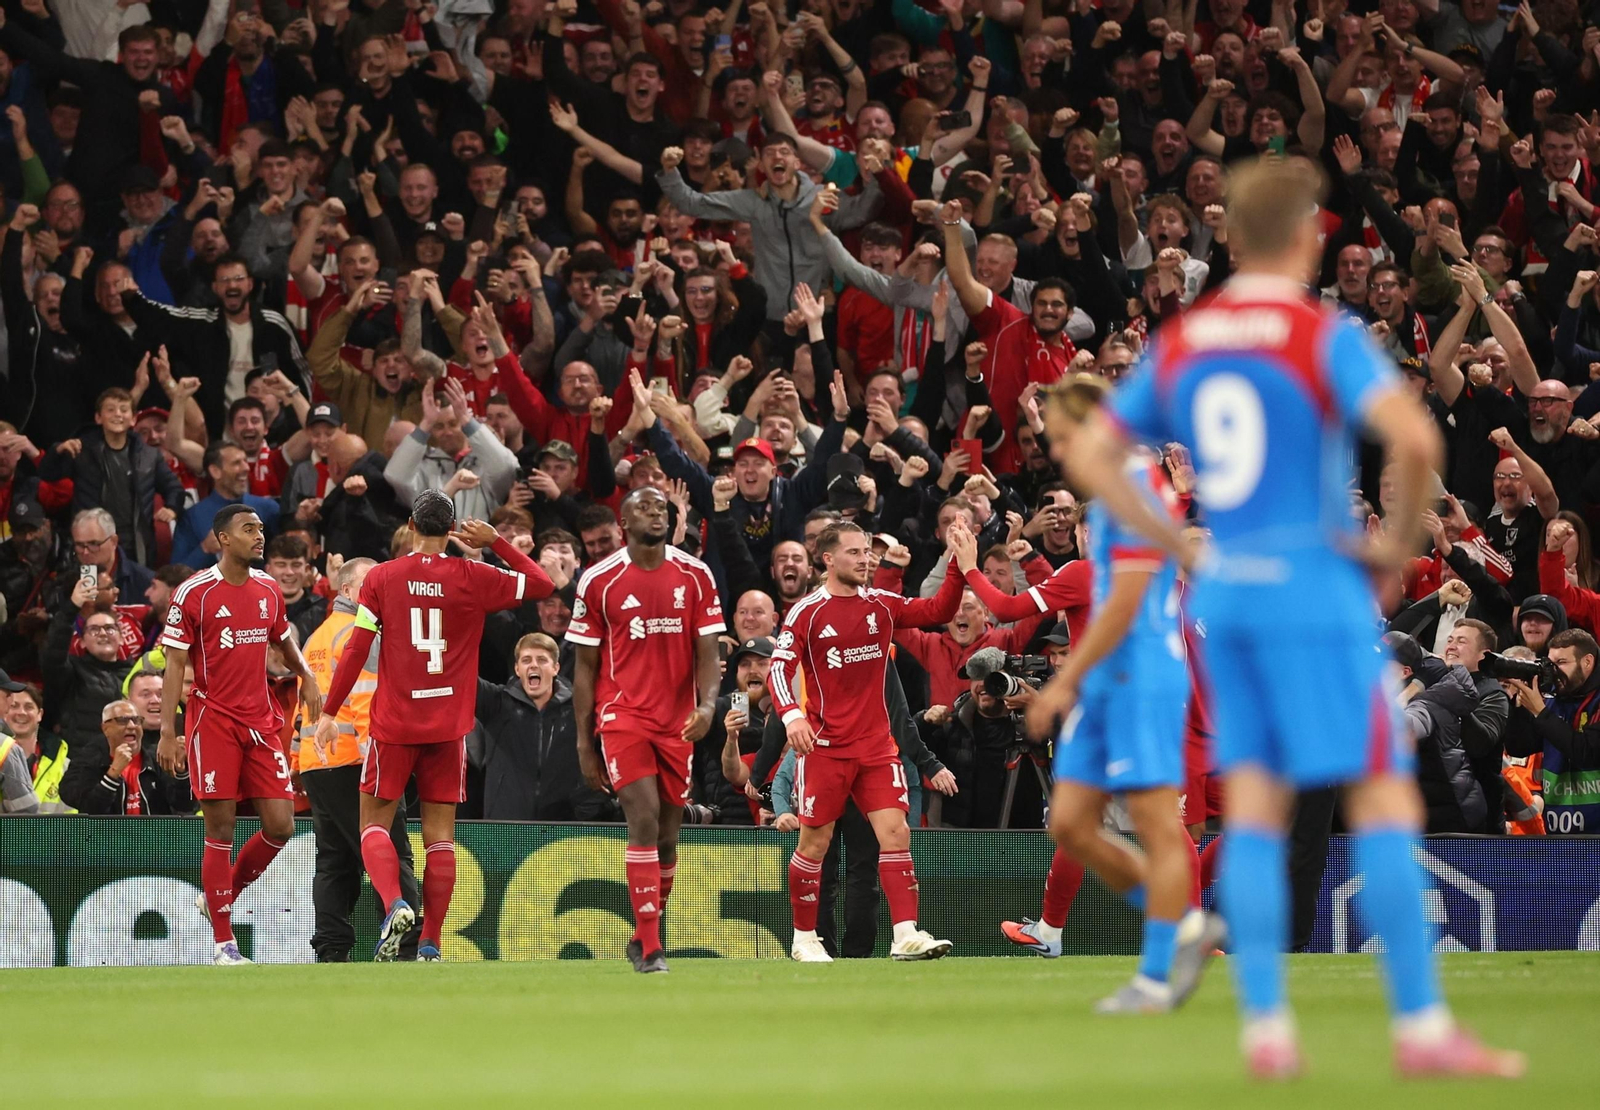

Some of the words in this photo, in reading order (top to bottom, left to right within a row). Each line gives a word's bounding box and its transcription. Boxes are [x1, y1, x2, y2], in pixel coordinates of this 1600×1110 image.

[1191, 371, 1268, 512] 9
[407, 580, 445, 597] VIRGIL
[646, 617, 682, 626] standard
[235, 627, 268, 637] standard
[646, 625, 683, 634] chartered
[235, 635, 268, 644] chartered
[410, 607, 447, 674] 4
[843, 643, 879, 656] standard
[844, 651, 883, 664] chartered
[419, 688, 451, 697] Foundation
